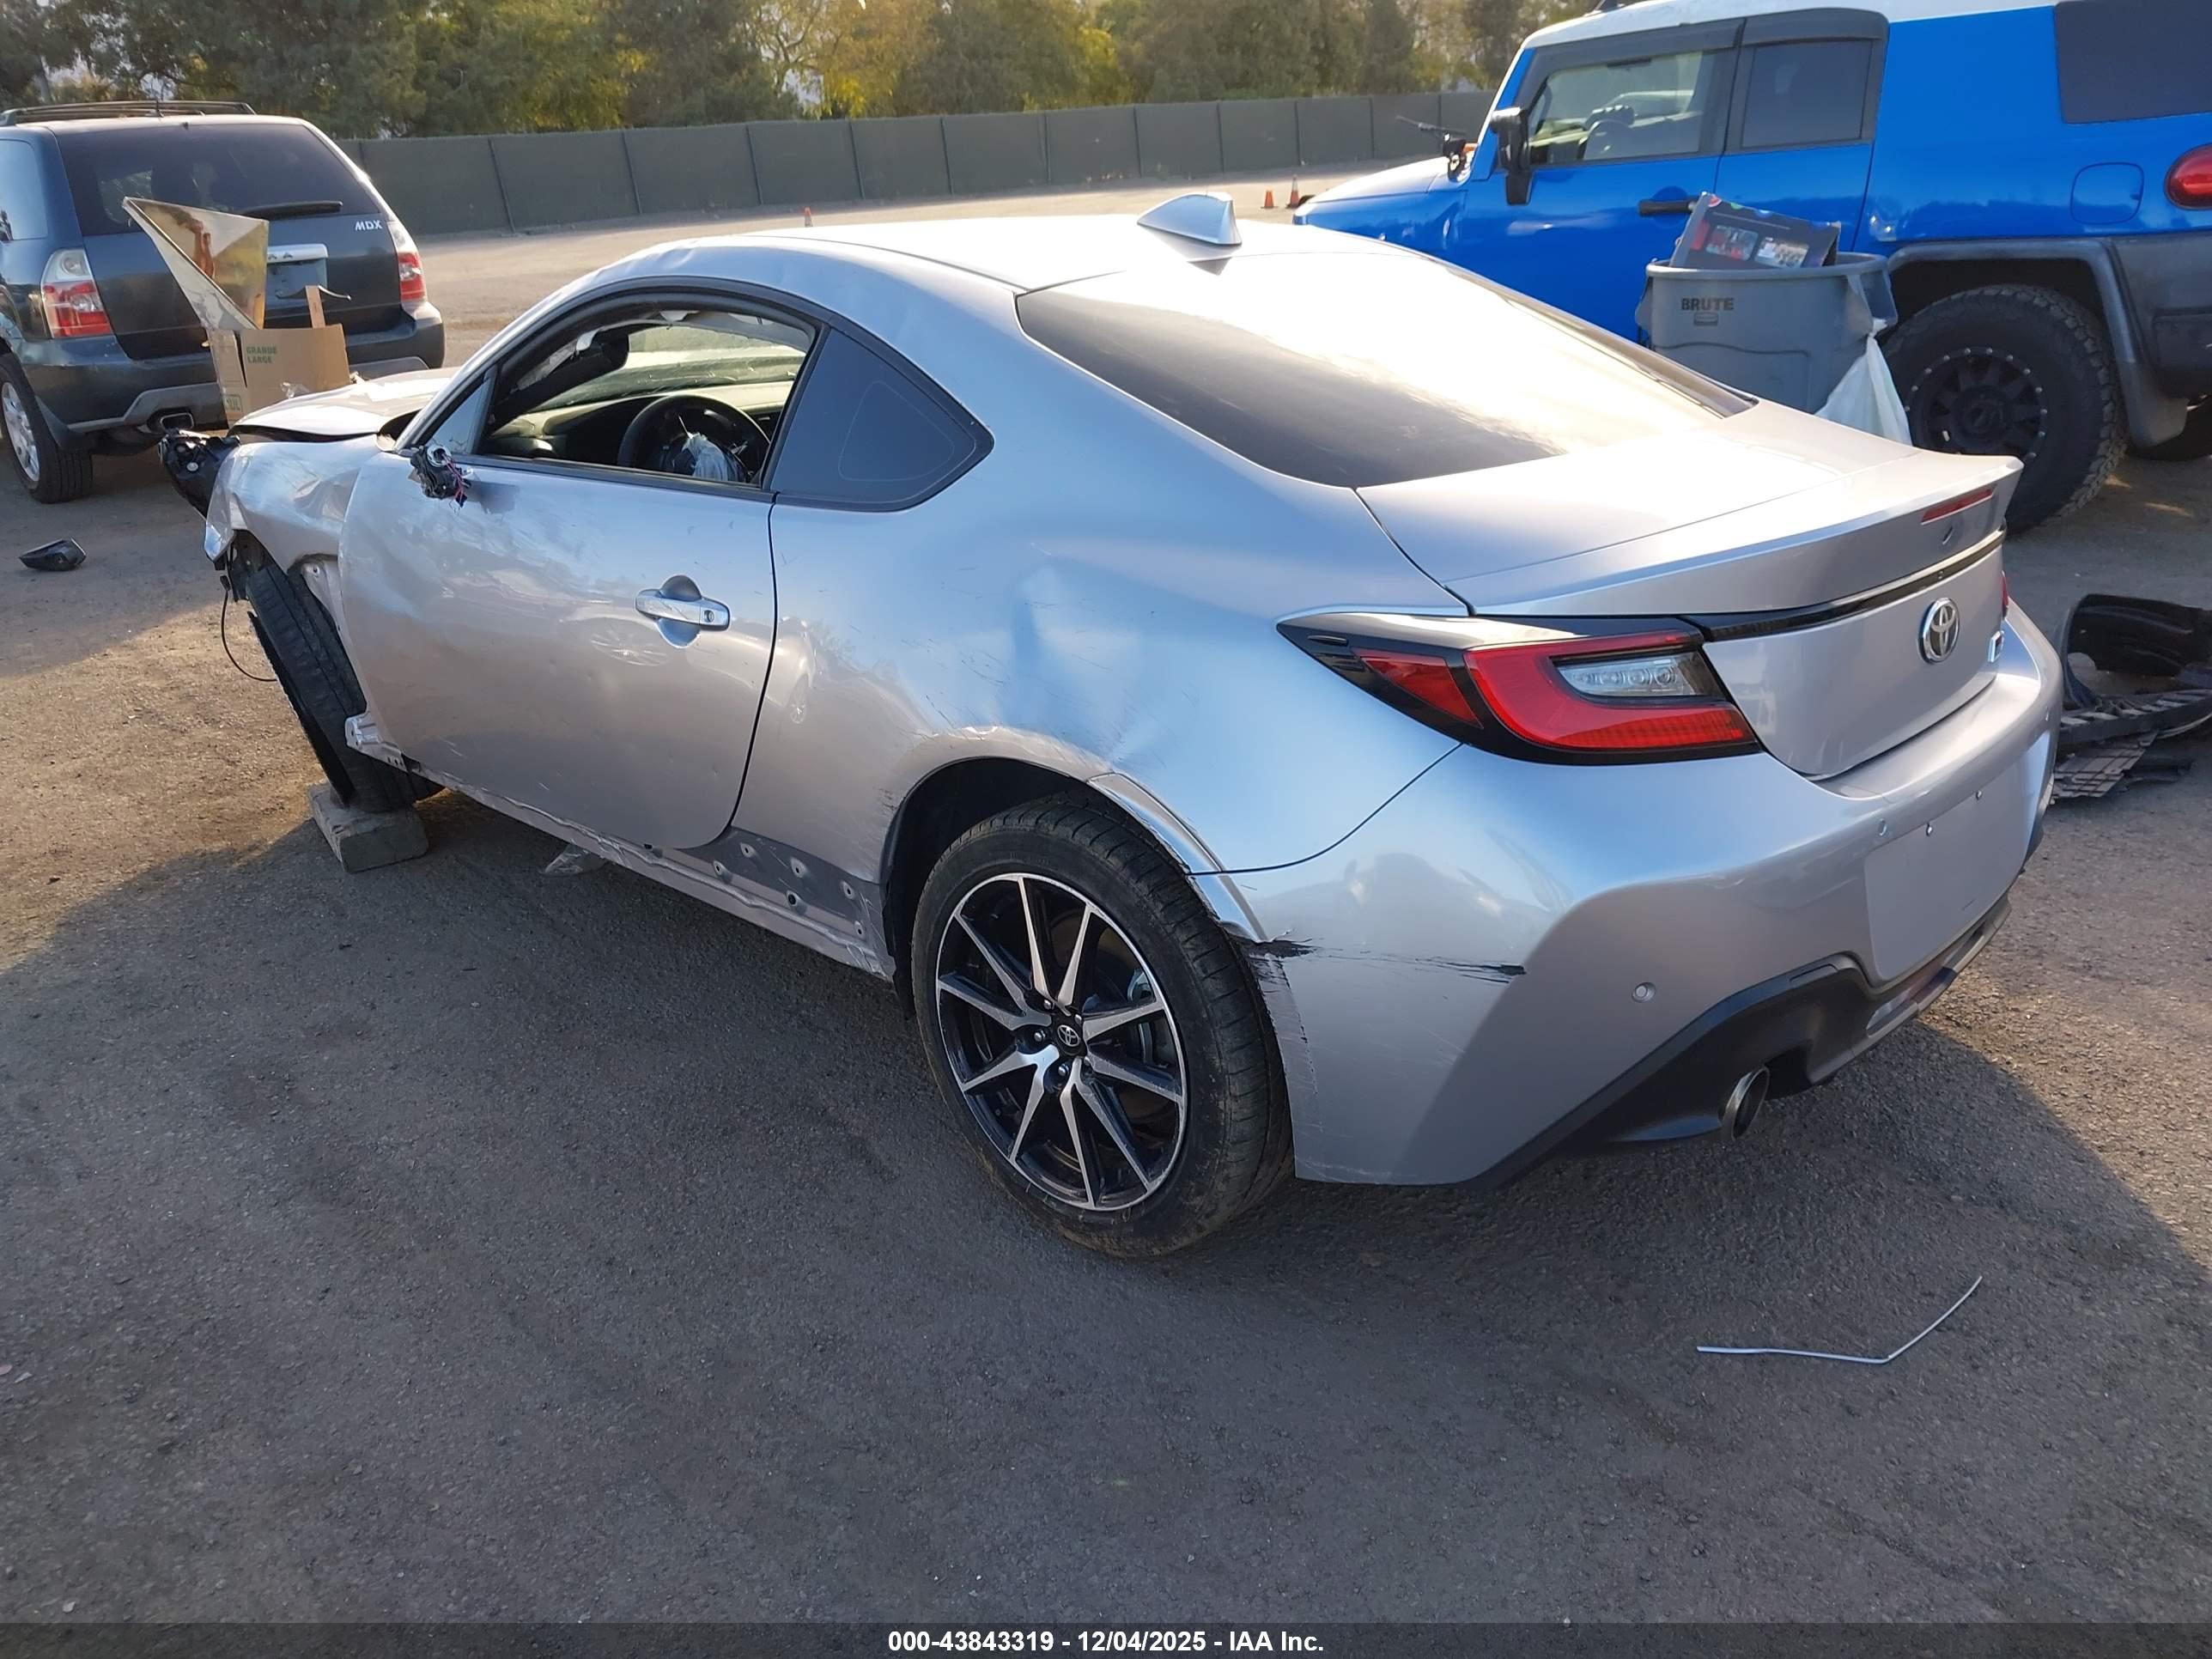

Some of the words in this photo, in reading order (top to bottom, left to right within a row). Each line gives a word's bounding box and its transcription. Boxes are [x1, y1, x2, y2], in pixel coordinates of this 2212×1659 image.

[355, 220, 383, 231] MDX
[1681, 297, 1735, 311] BRUTE
[246, 346, 277, 355] GRANDE
[246, 356, 272, 364] LARGE
